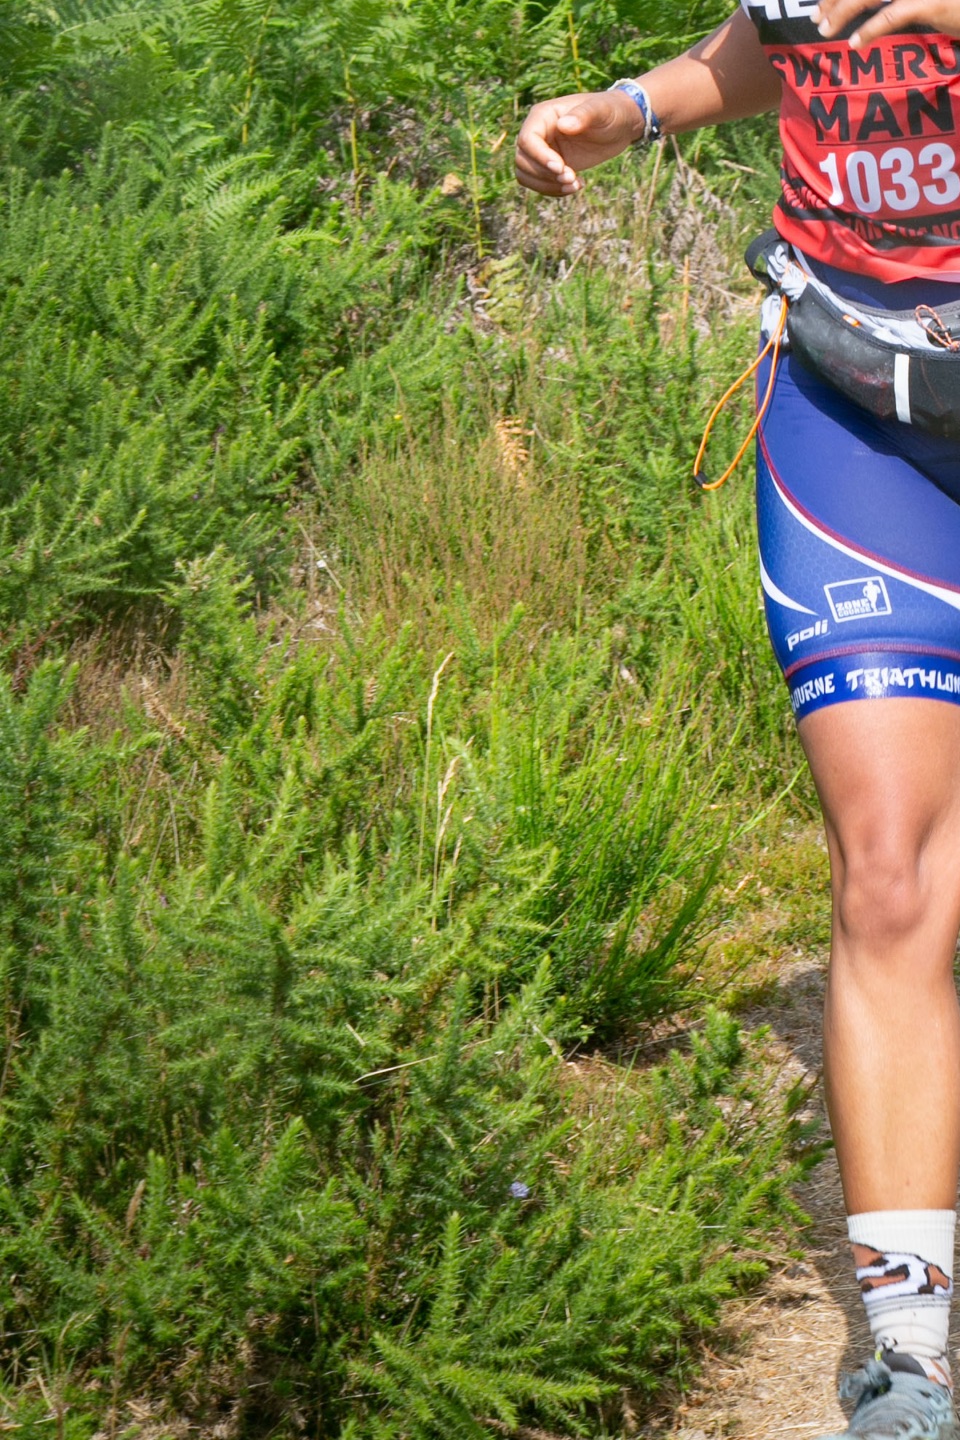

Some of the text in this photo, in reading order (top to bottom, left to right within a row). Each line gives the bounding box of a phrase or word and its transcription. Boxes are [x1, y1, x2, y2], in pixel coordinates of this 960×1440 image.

[809, 84, 956, 143] MAN
[835, 598, 871, 612] ZONE
[786, 620, 828, 652] poli
[845, 666, 960, 695] TRIATHLON
